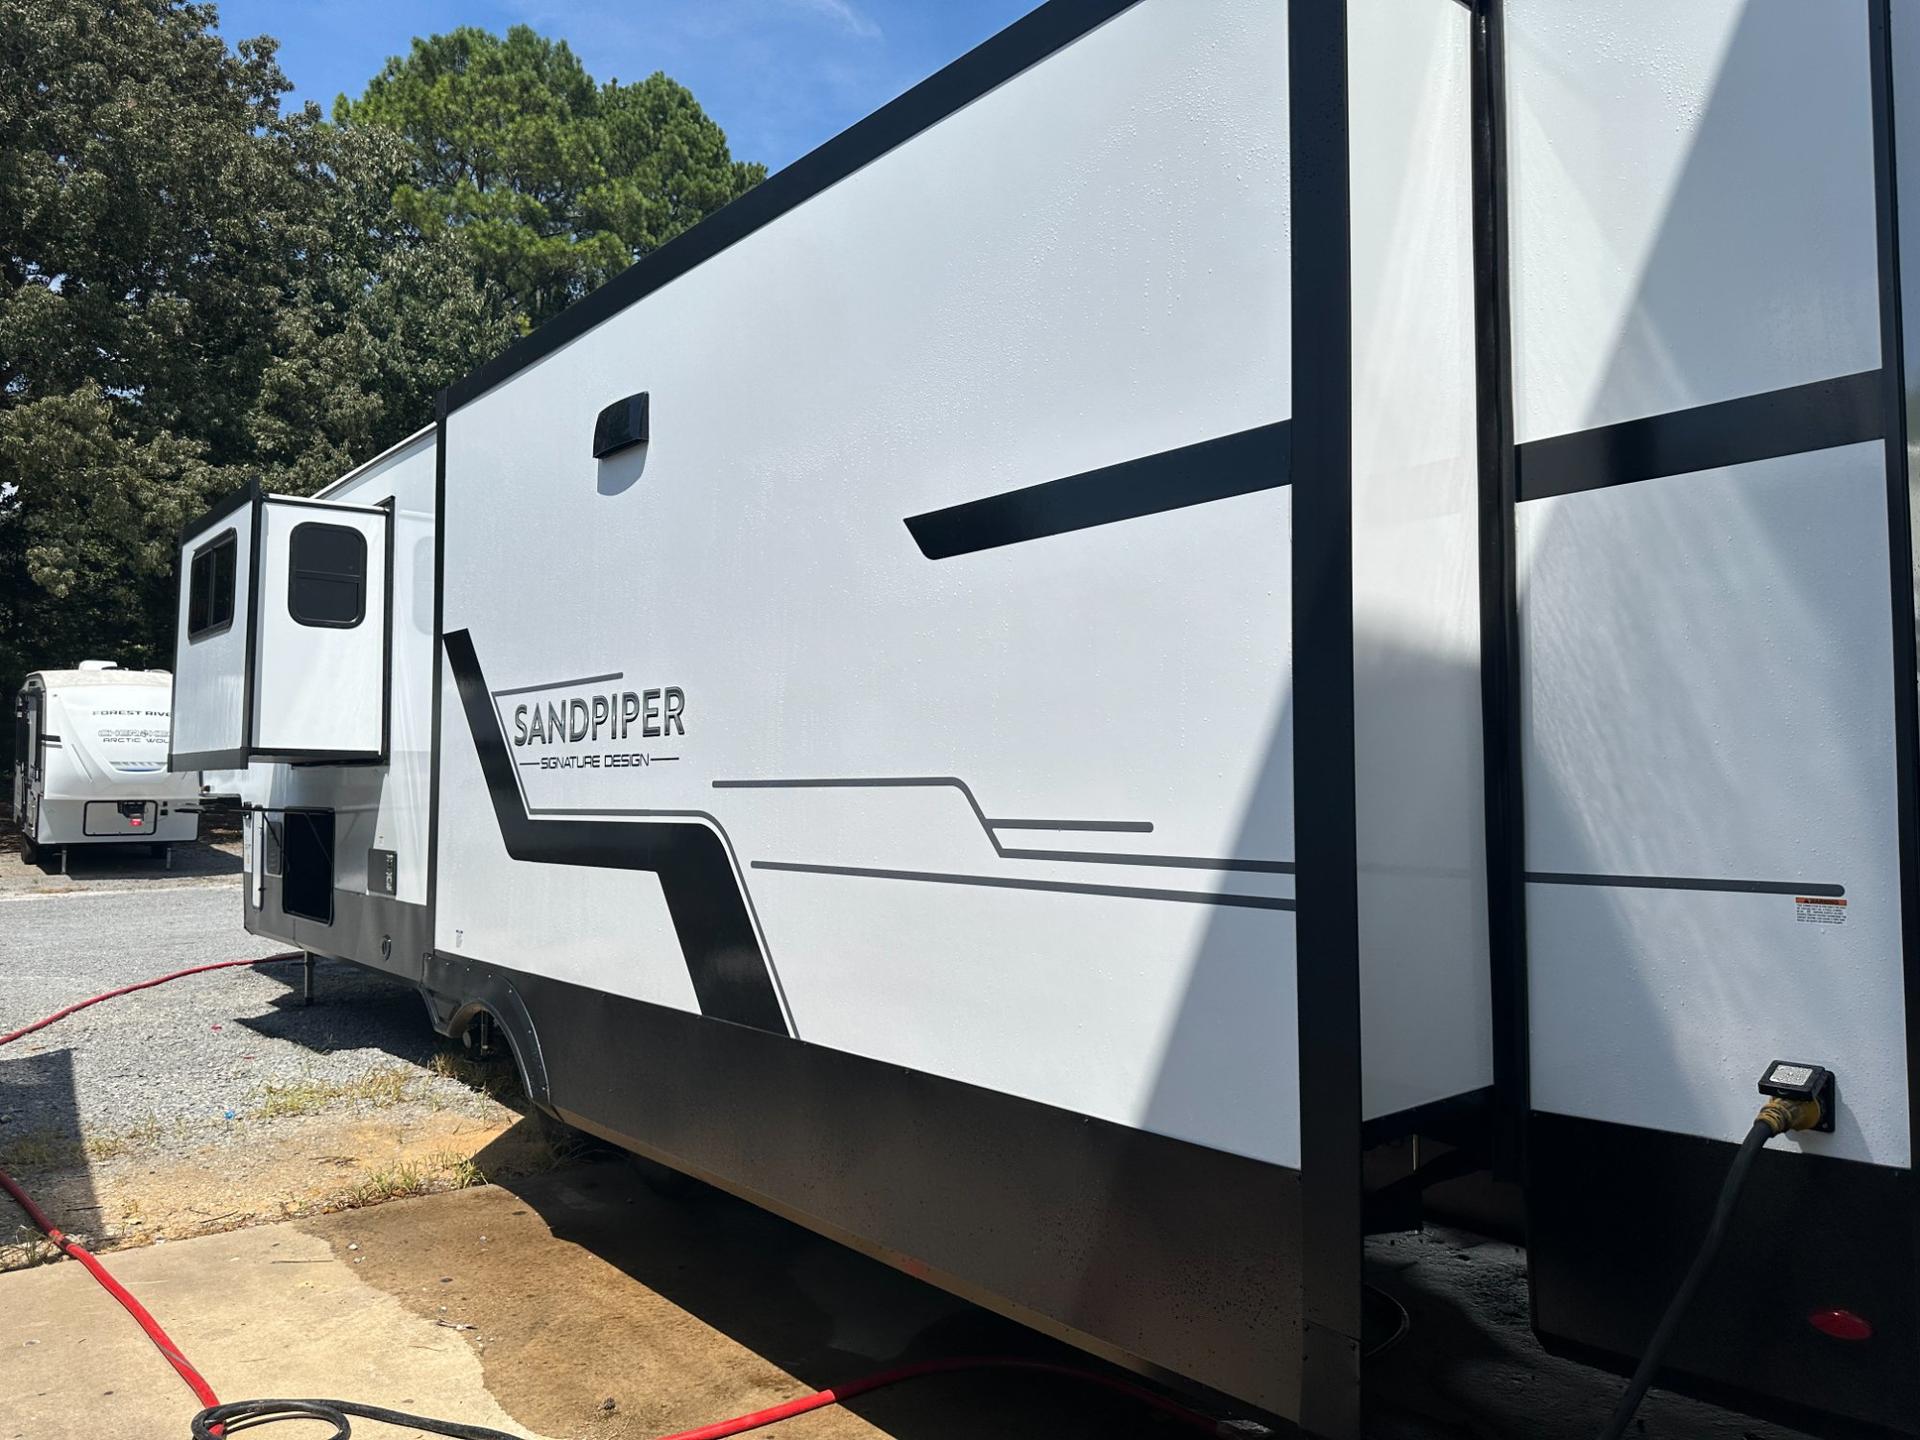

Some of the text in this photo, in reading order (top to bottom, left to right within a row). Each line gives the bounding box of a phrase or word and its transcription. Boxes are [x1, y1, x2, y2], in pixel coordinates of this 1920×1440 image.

[514, 686, 685, 747] SANDPIPER
[540, 753, 650, 769] SIGNATURE DESIGN
